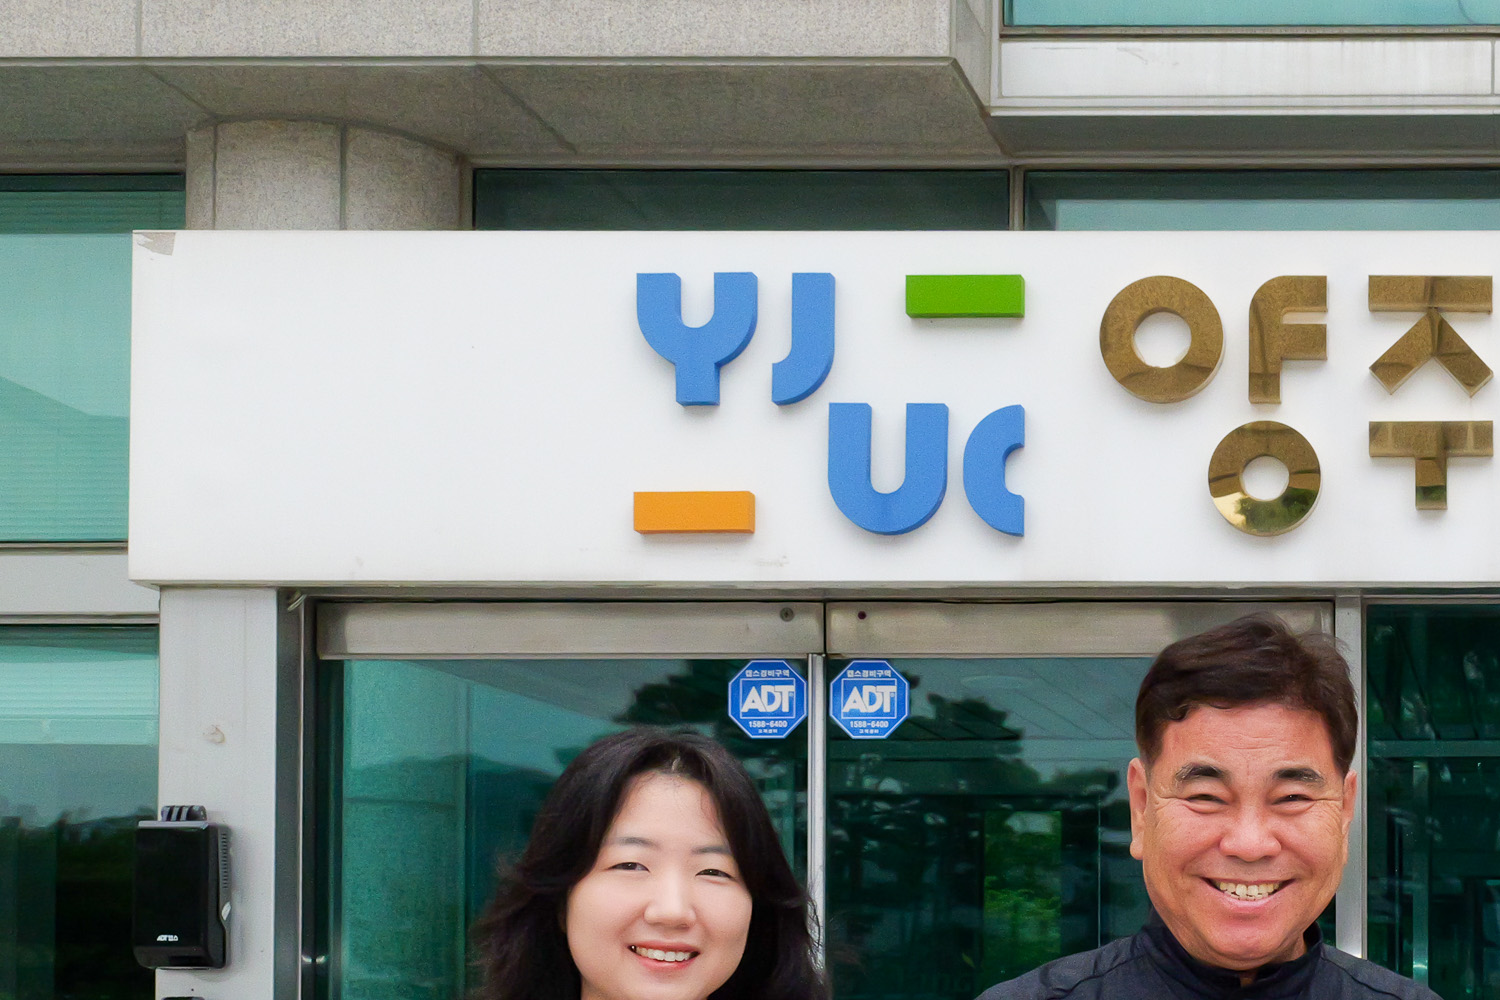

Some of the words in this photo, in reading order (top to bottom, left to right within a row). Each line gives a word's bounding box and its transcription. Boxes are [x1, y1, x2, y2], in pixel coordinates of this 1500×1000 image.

[741, 685, 795, 713] ADT
[842, 685, 897, 713] ADT
[749, 720, 788, 728] 1588-6400
[850, 720, 889, 728] 1588-6400
